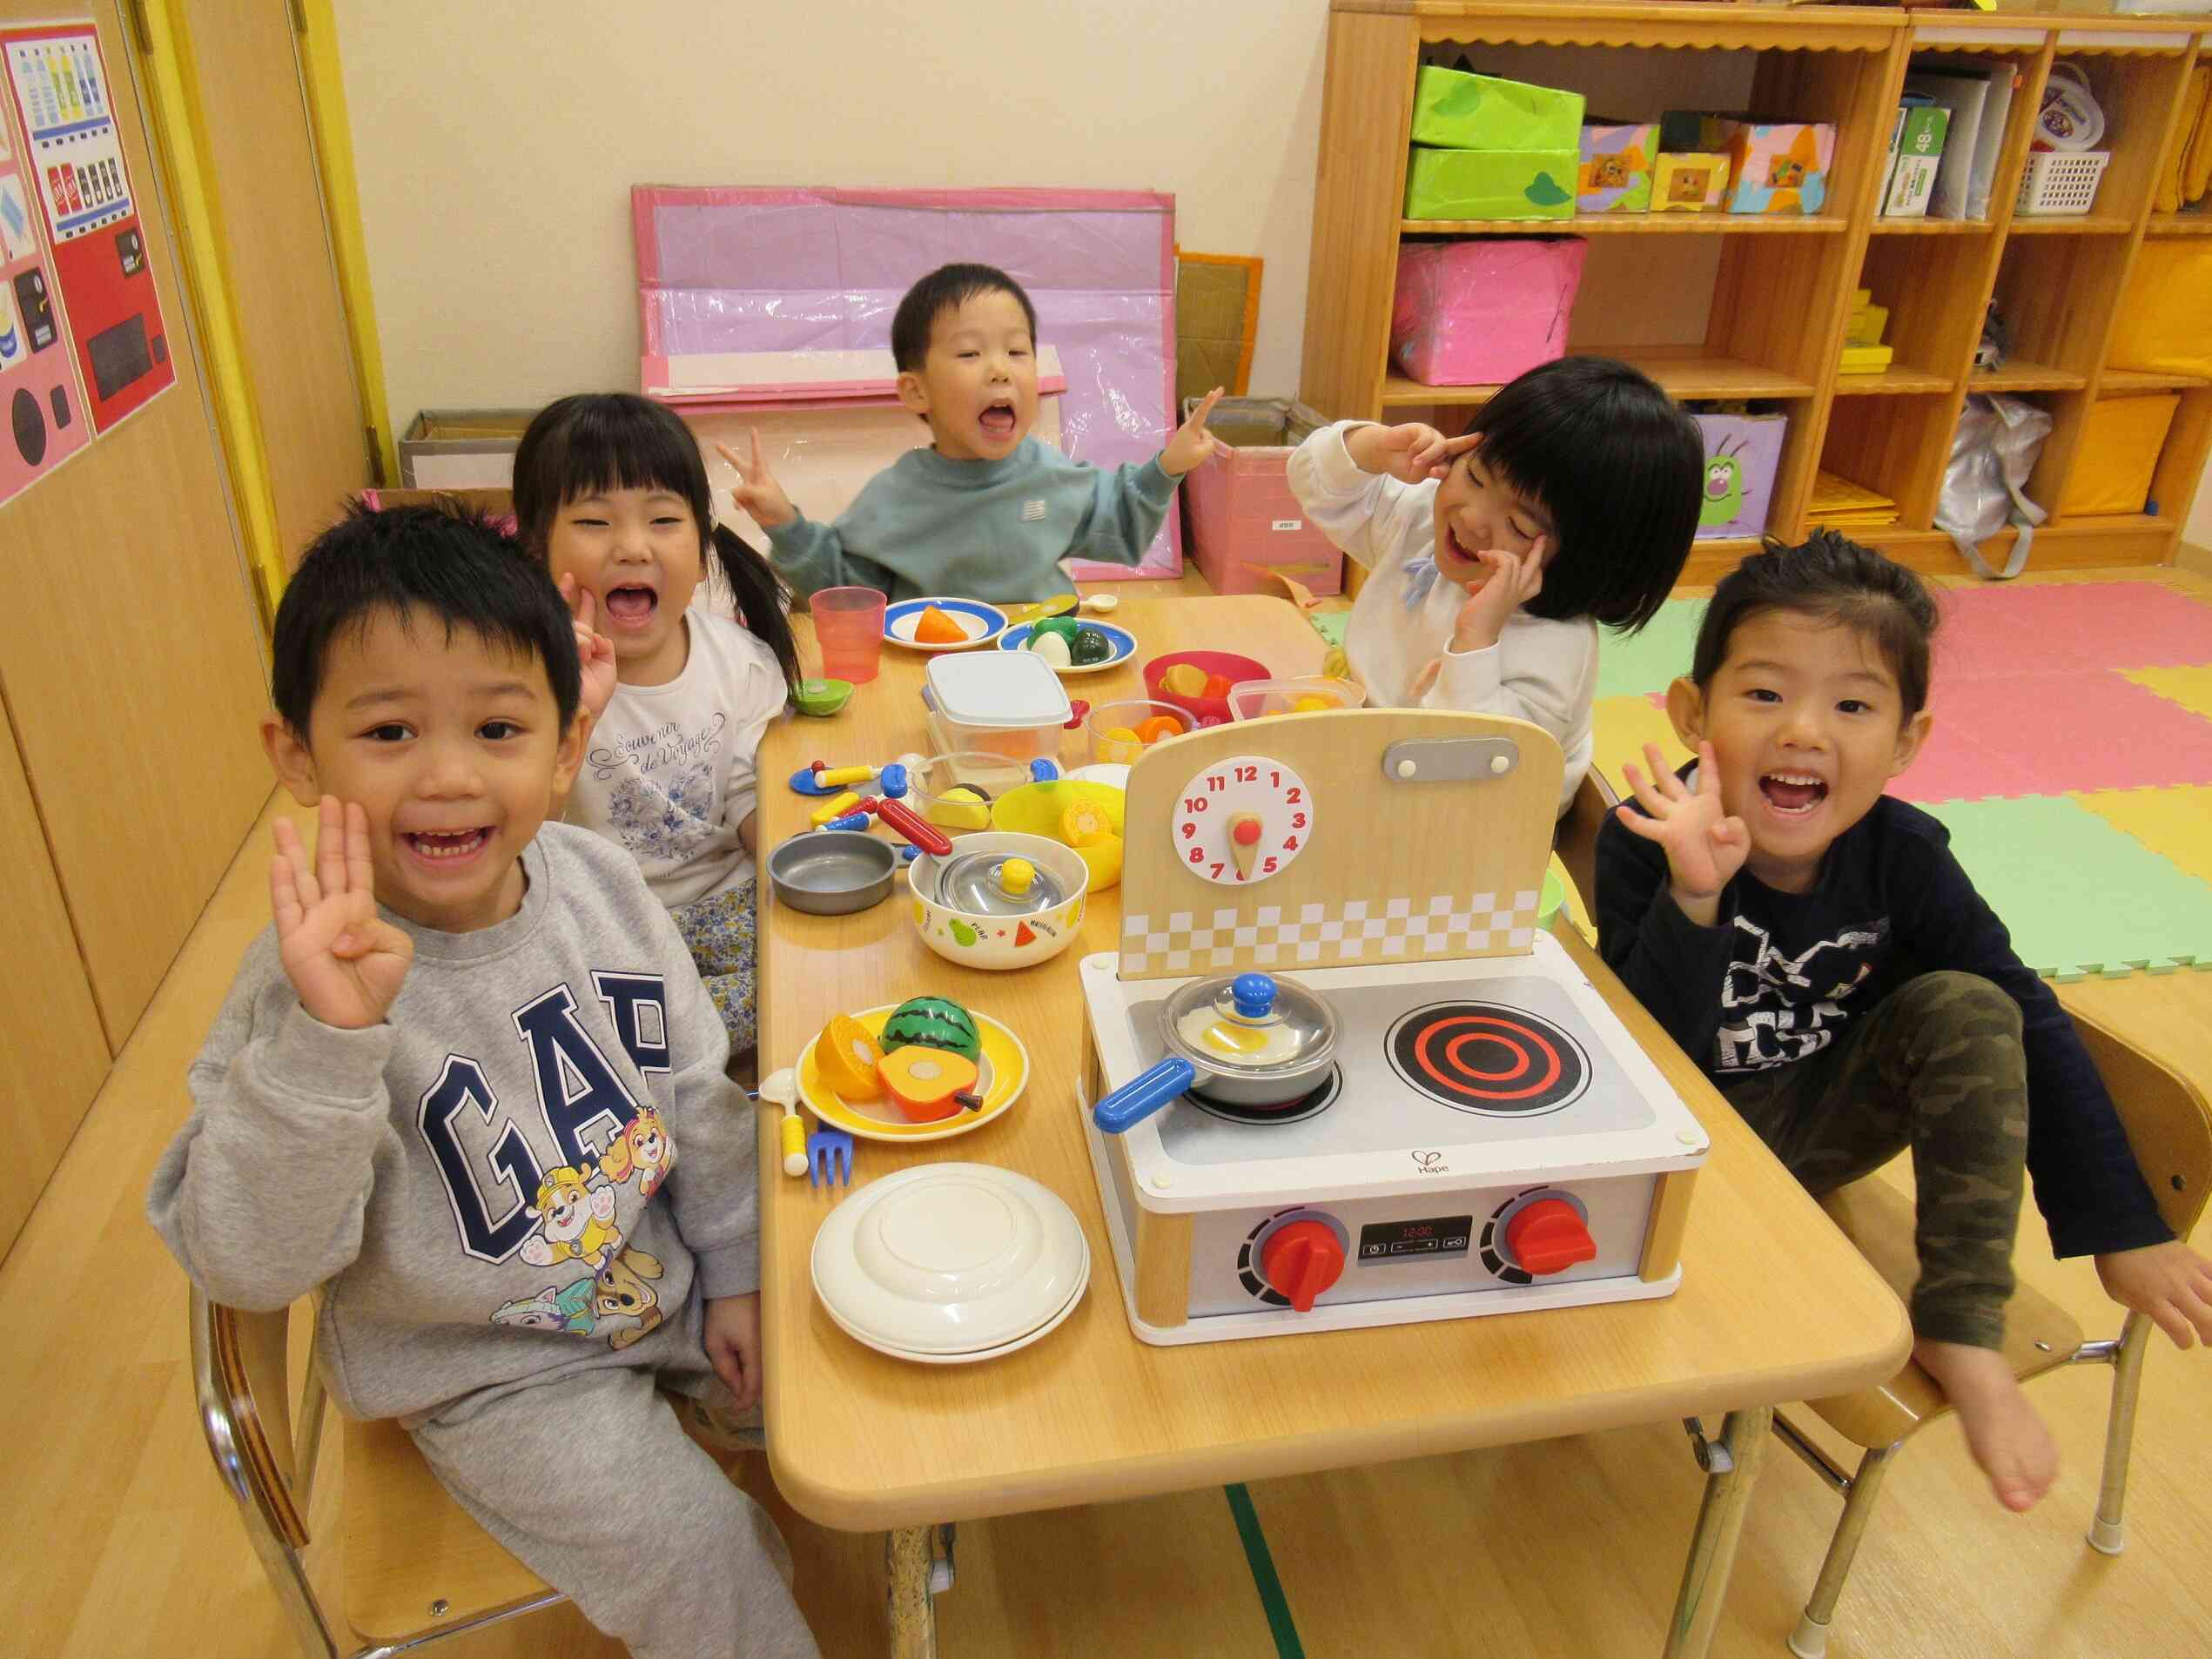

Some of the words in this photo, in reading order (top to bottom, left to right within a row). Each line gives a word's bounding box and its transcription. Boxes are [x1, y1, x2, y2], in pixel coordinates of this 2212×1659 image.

[614, 722, 680, 759] Souvenir
[641, 754, 657, 774] de
[657, 728, 711, 767] Voyage
[1234, 766, 1257, 782] 12
[1270, 771, 1280, 788] 1
[1207, 776, 1225, 791] 11
[1287, 788, 1301, 804] 2
[1184, 797, 1208, 813] 10
[1292, 812, 1306, 828] 3
[1181, 823, 1196, 839] 9
[1283, 836, 1298, 850] 4
[1189, 847, 1204, 863] 8
[1210, 863, 1225, 879] 7
[1263, 856, 1277, 873] 5
[417, 969, 671, 1266] GAP
[1418, 1165, 1449, 1174] Hape
